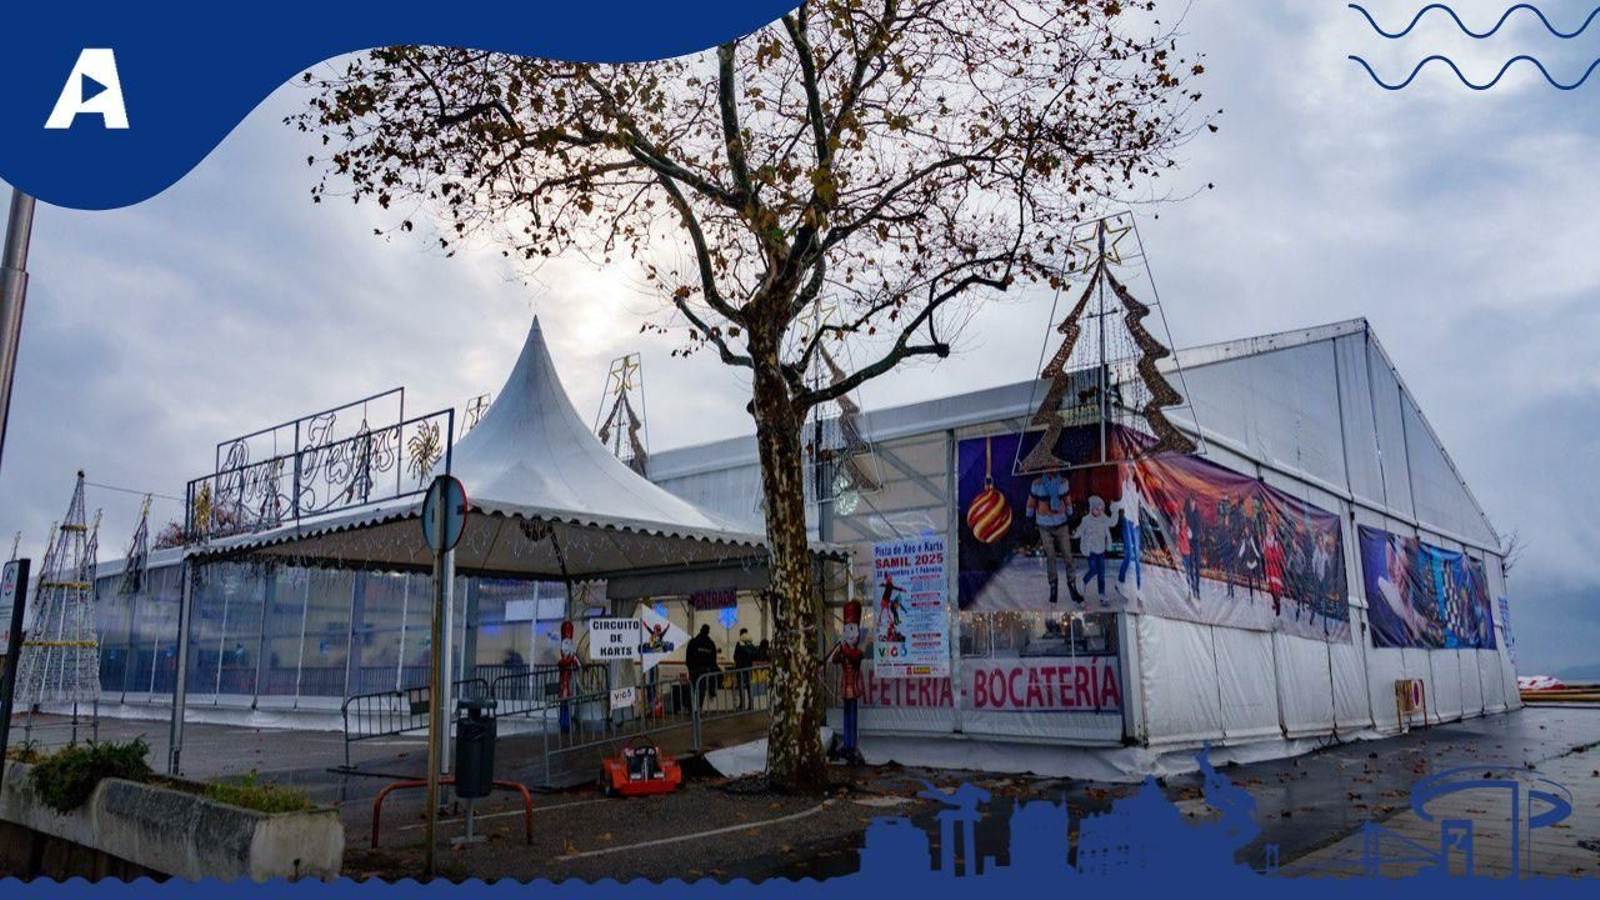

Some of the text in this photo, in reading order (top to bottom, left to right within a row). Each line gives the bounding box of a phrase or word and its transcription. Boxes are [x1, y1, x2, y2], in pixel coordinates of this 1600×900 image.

[875, 553, 944, 569] SAMIL 2025
[592, 620, 639, 631] CIRCUITO
[610, 633, 623, 643] DE
[600, 647, 632, 656] KARTS
[974, 659, 1120, 708] BOCATERÍA
